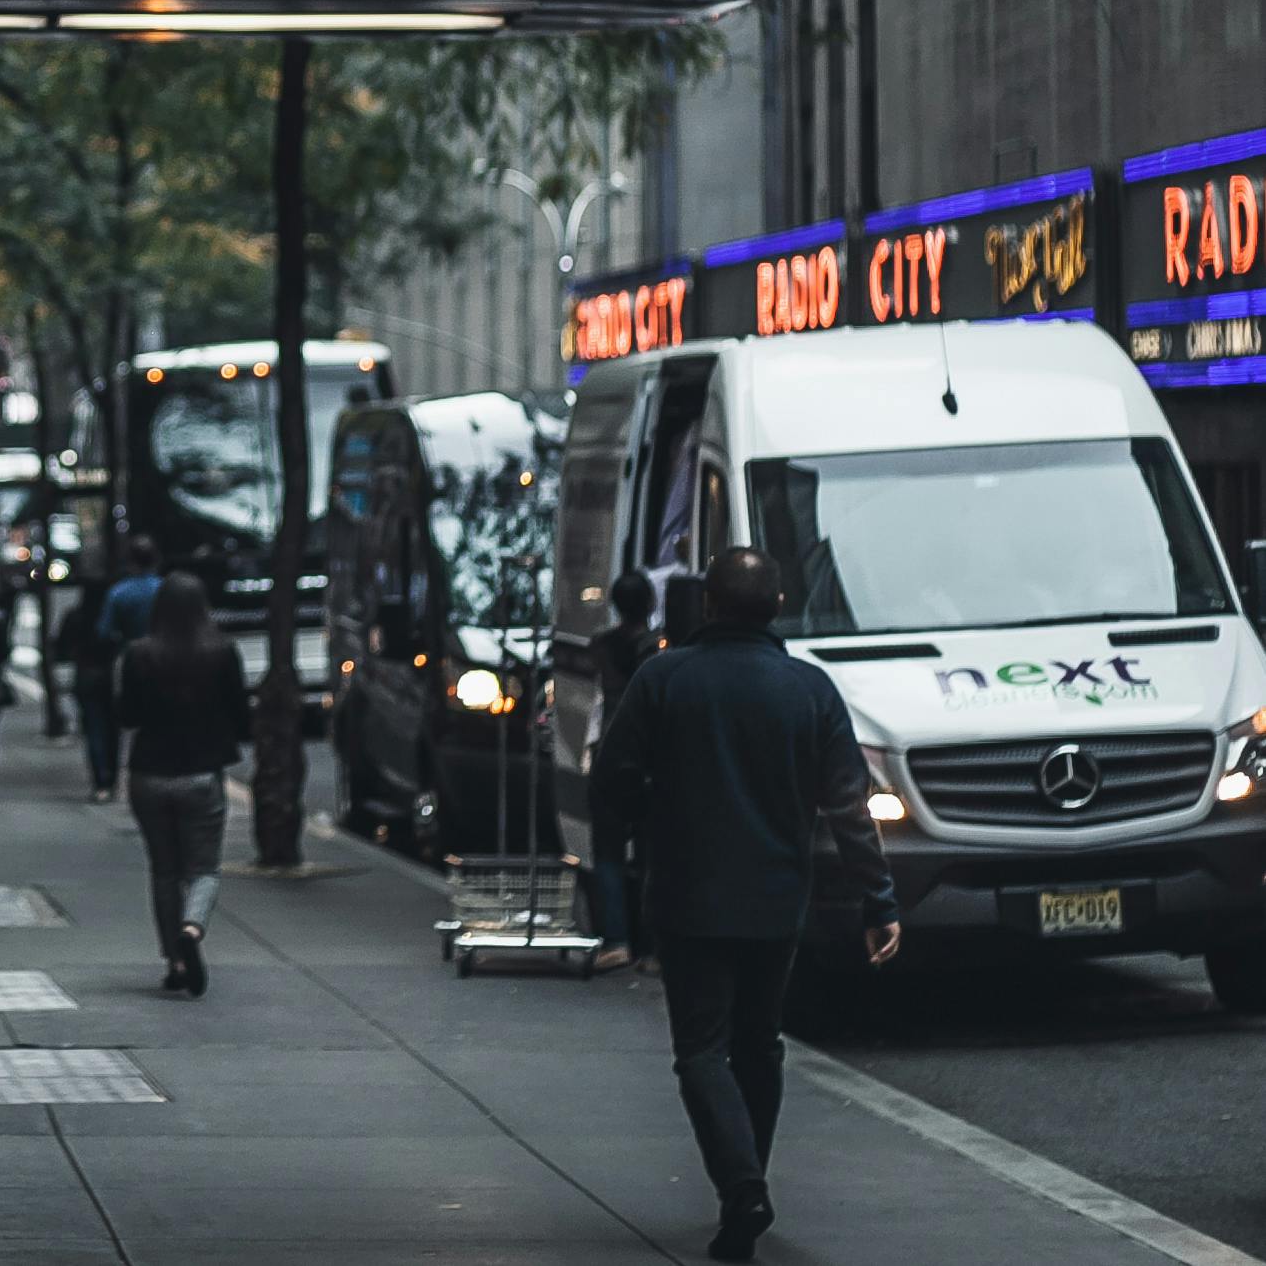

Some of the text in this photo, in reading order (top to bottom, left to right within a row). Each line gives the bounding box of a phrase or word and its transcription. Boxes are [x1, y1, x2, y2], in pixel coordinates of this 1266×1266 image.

[756, 246, 840, 336] RADIO
[868, 227, 946, 322] CITY
[1163, 173, 1266, 287] RAD
[934, 655, 1151, 693] next
